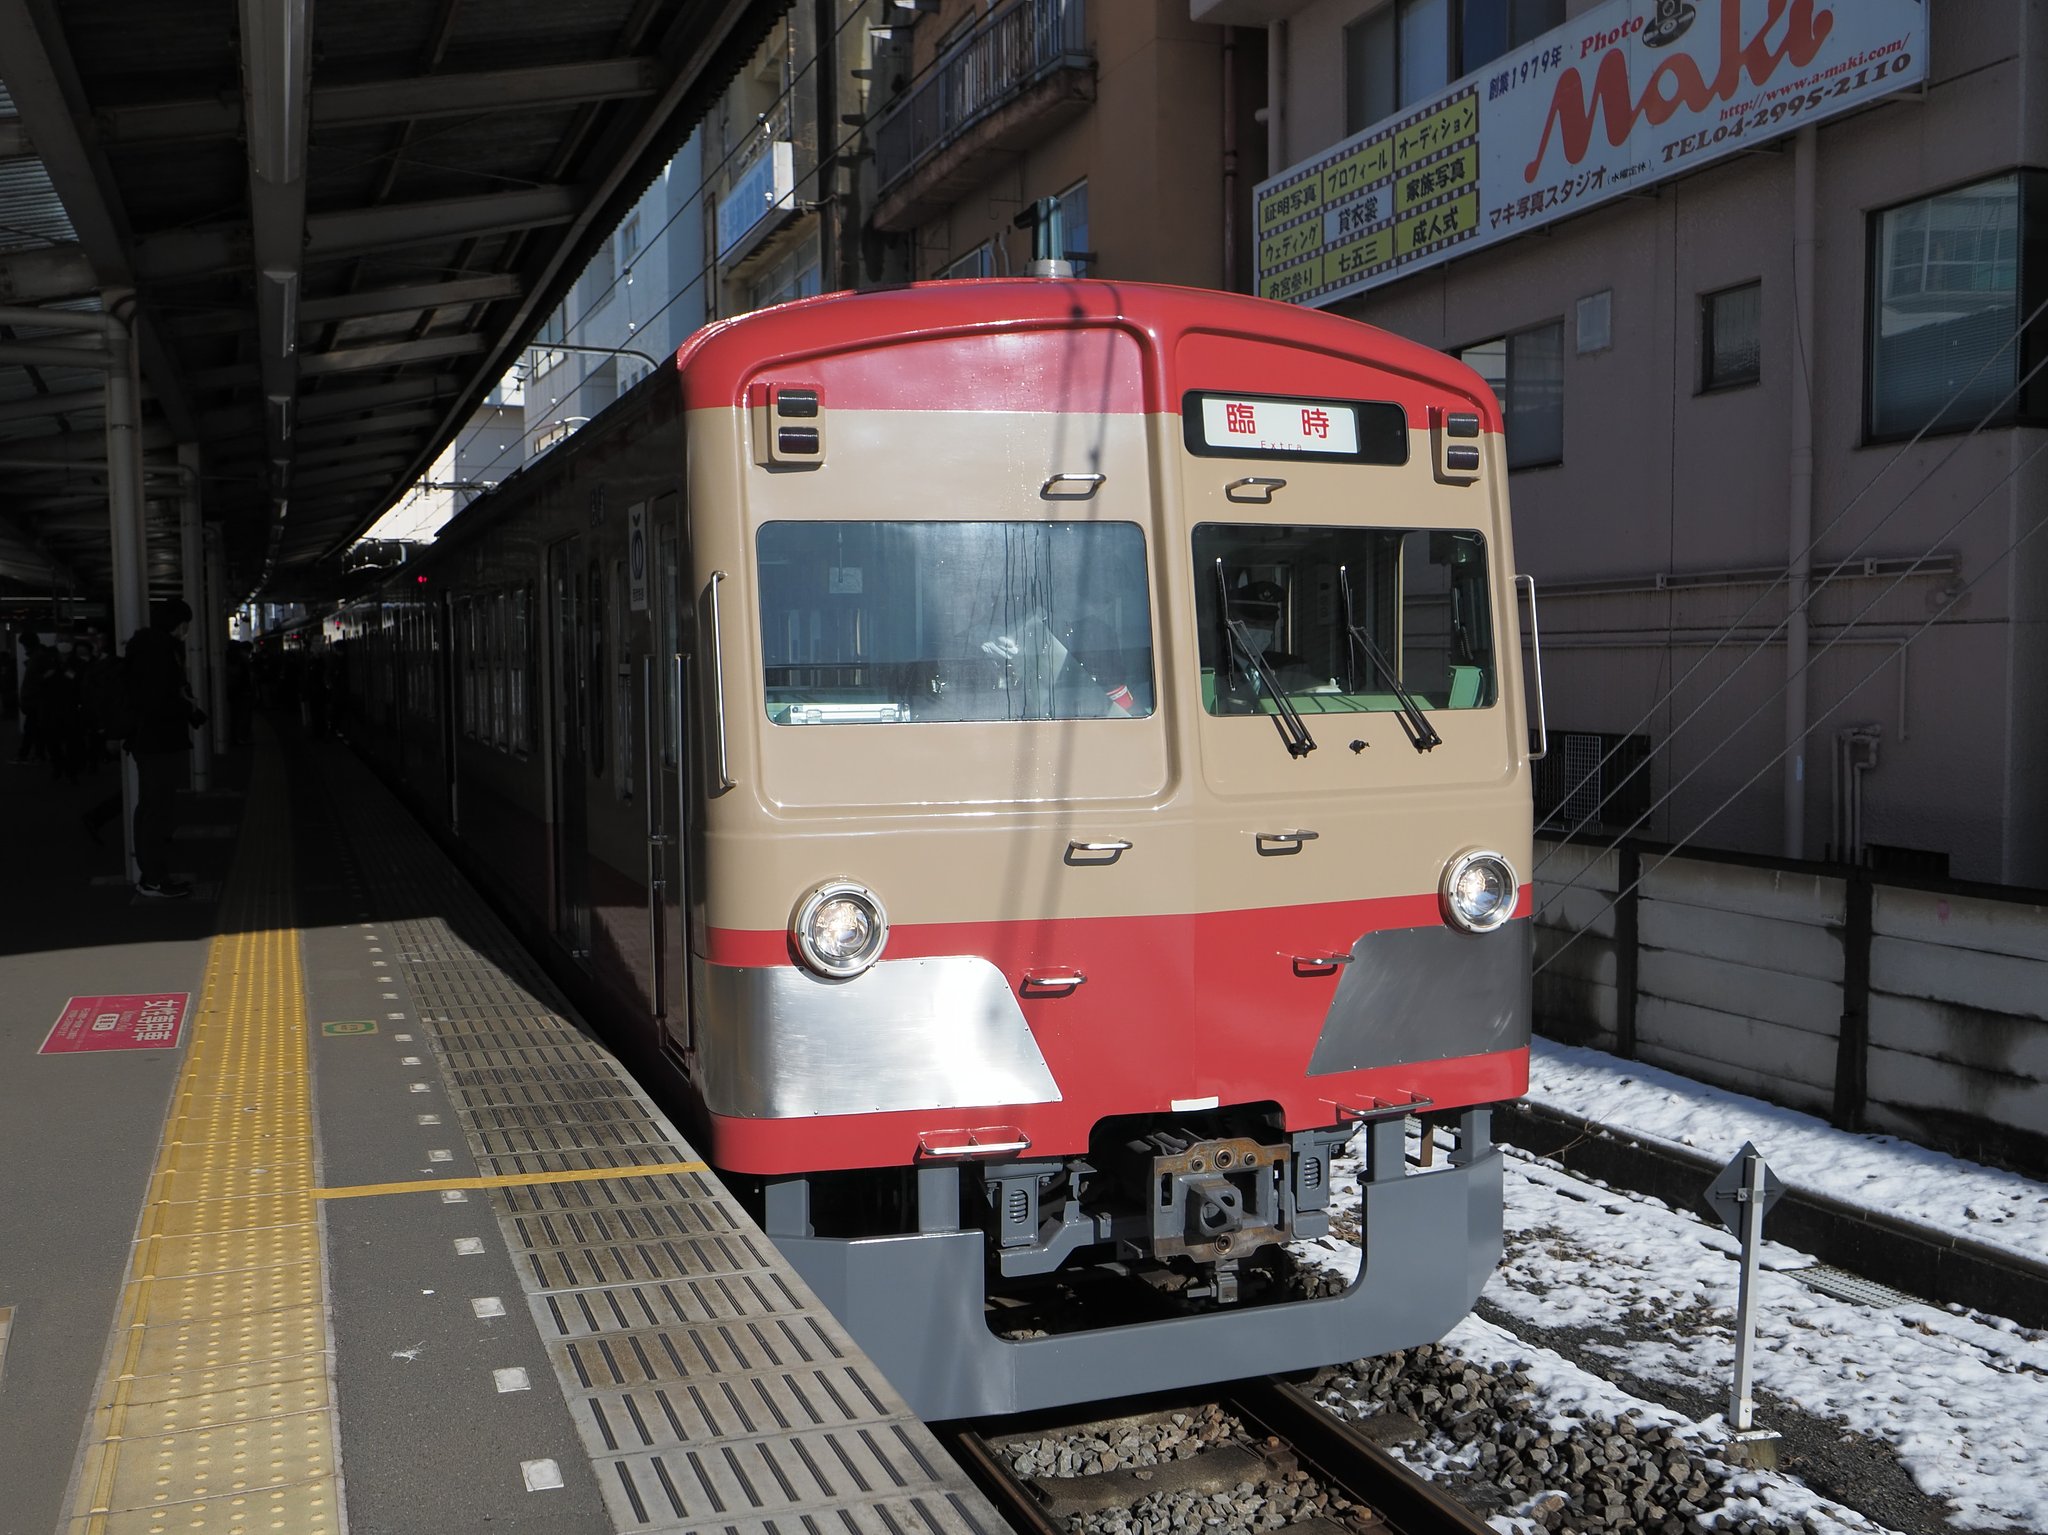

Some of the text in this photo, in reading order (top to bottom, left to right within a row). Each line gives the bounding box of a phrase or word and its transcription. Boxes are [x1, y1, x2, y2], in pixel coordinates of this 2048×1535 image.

[1579, 16, 1644, 59] Photo
[1524, 0, 1833, 183] Maki
[1719, 32, 1911, 122] http://www.a-maki.com/
[1399, 107, 1474, 160] オーディション
[1328, 149, 1388, 193] プロフィール
[1406, 157, 1466, 203] 家族写真
[1264, 184, 1317, 223] 証明写真
[1489, 165, 1607, 231] マキ写真スタジオ
[1265, 224, 1319, 262] ウェディング
[1412, 206, 1460, 247] 成人式
[1338, 241, 1378, 274] 七五三
[1260, 440, 1302, 451] Extra
[131, 1000, 180, 1041] 女性専用車
